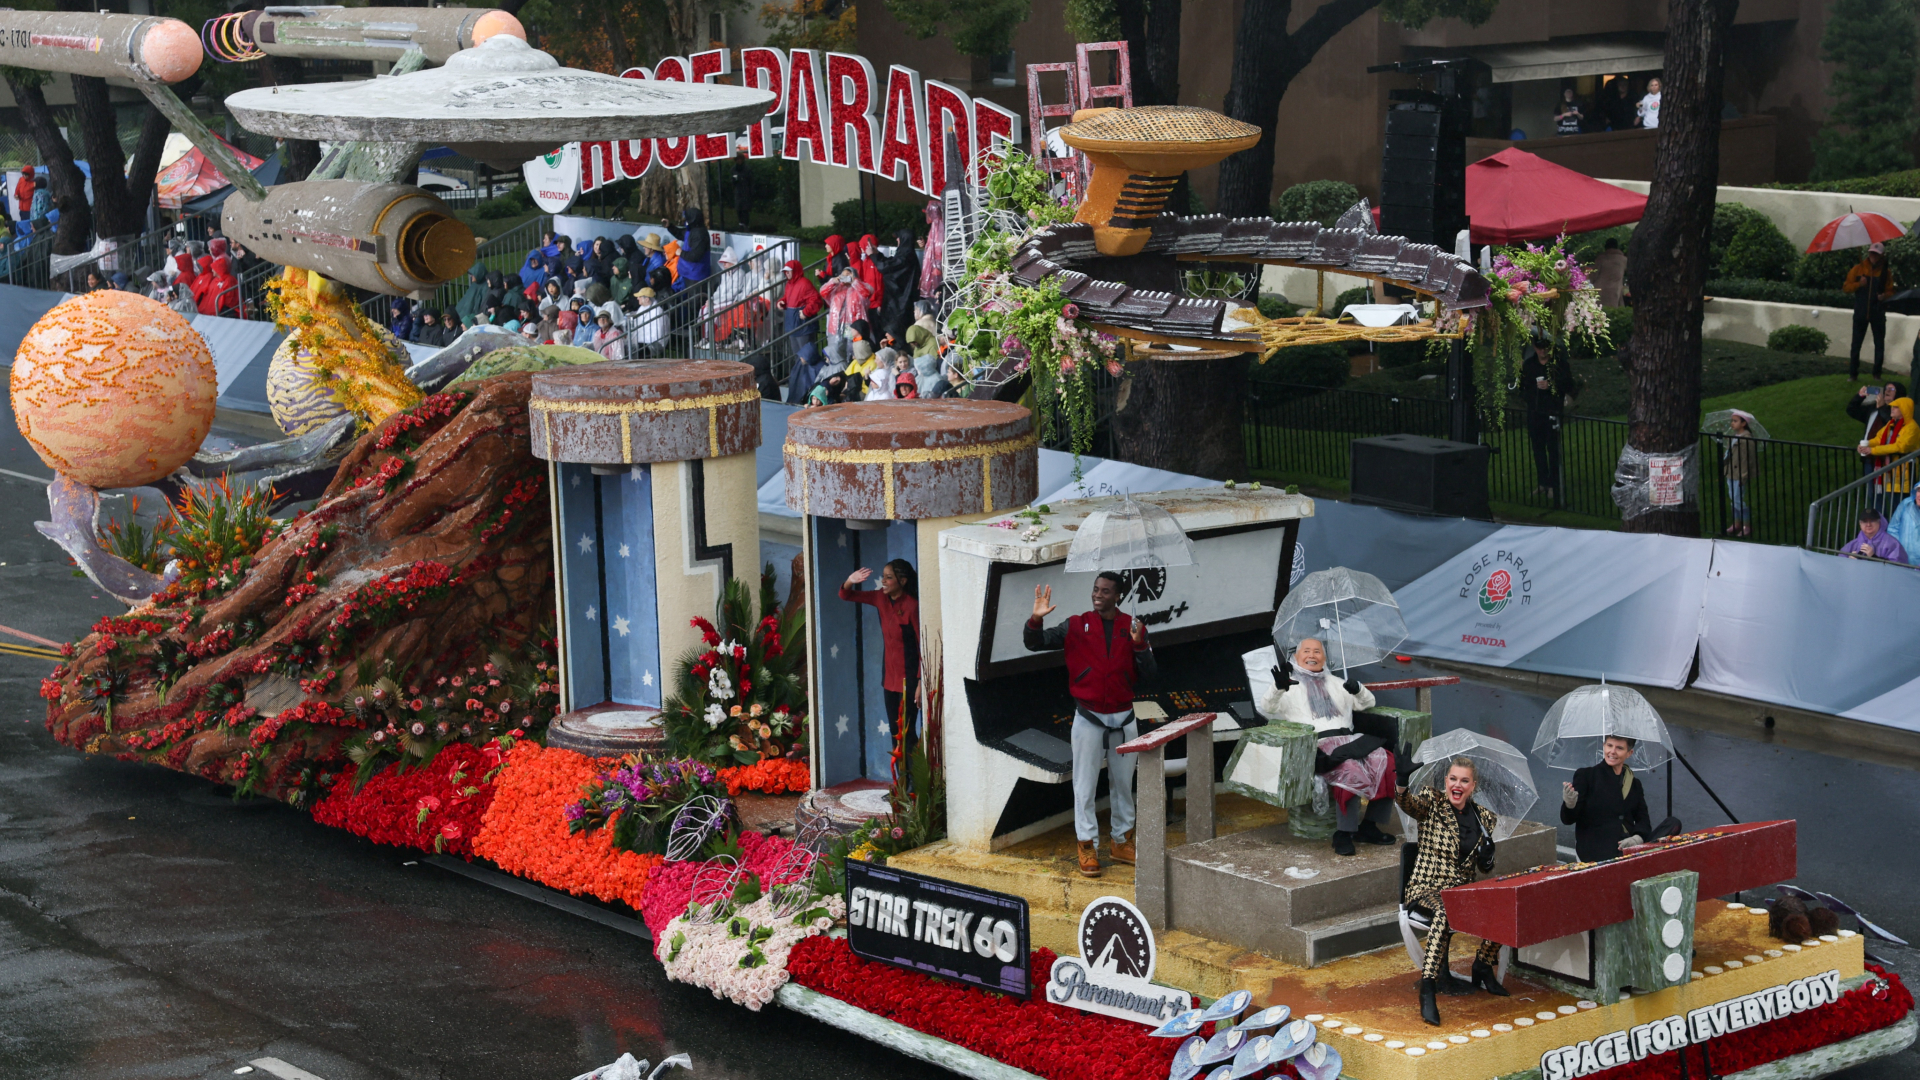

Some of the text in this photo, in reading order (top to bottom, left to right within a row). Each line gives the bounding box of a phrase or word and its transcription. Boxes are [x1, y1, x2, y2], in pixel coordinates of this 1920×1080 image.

[539, 190, 570, 201] HONDA
[711, 233, 721, 246] 15
[1662, 467, 1672, 475] NO
[1460, 550, 1532, 606] ROSE PARADE
[1496, 623, 1502, 631] by
[1461, 634, 1507, 648] HONDA
[850, 887, 1018, 963] STAR TREK 60
[1050, 961, 1187, 1020] Paramount+
[1545, 971, 1840, 1080] SPACE FOR EVERYBODY
